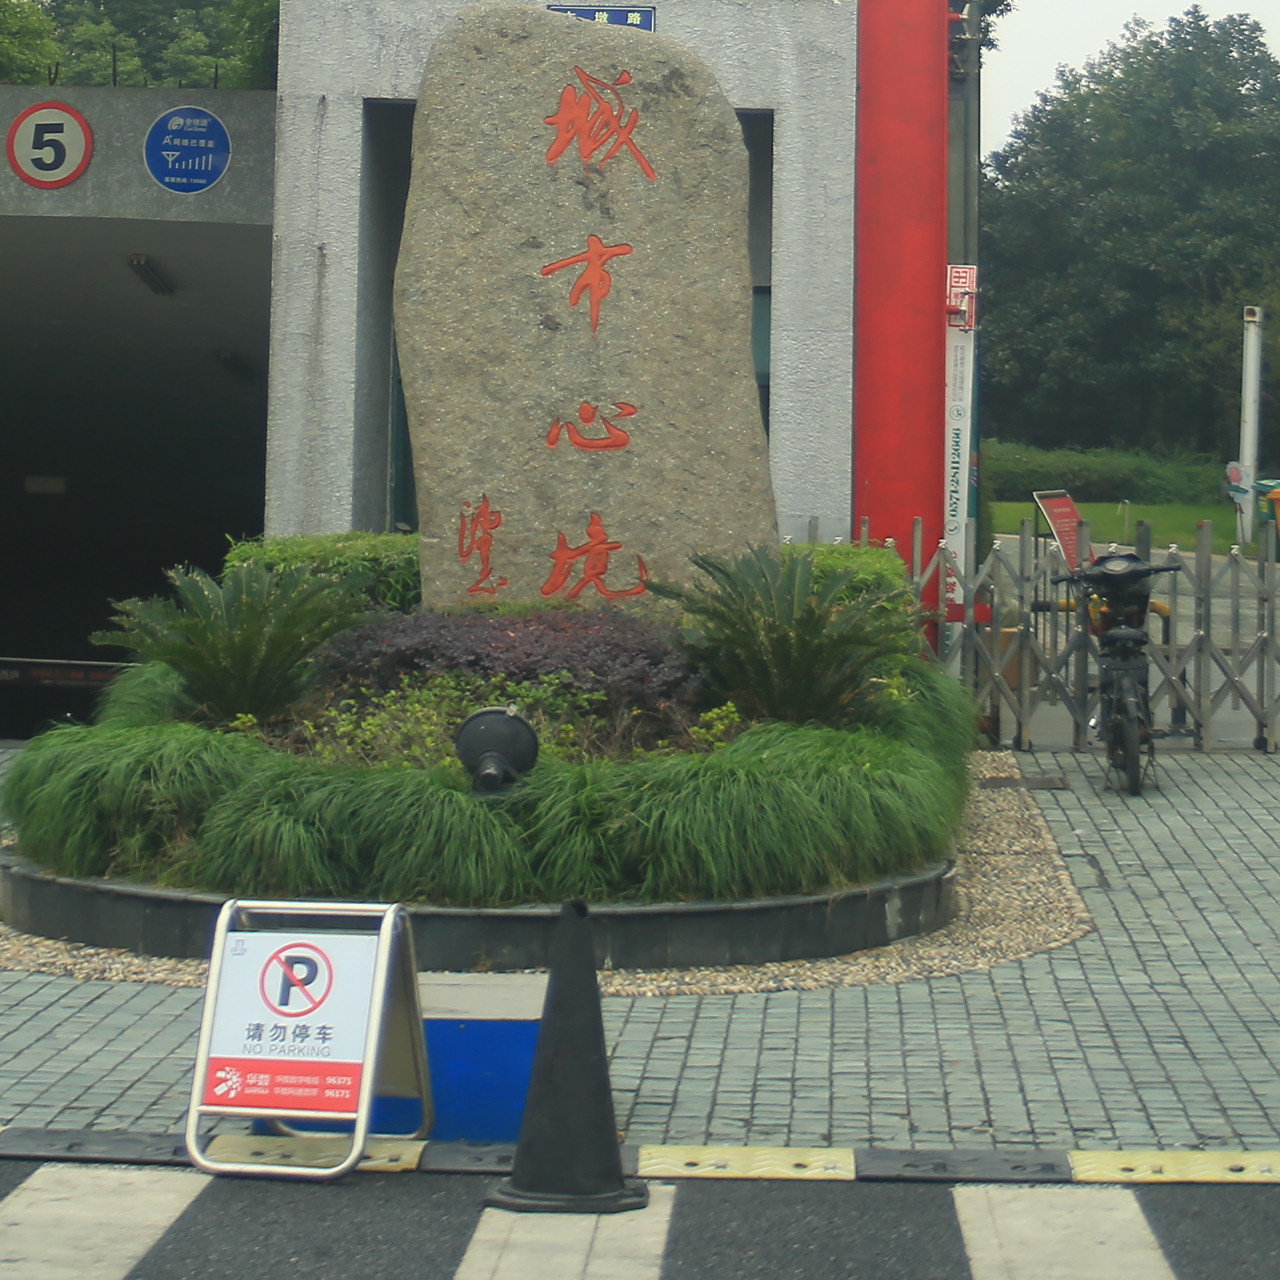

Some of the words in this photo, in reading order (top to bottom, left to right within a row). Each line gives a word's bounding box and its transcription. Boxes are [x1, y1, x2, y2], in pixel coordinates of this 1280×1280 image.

[30, 122, 67, 172] 5
[245, 1022, 335, 1044] 请勿停车
[242, 1043, 263, 1056] NO
[268, 1044, 332, 1058] PARKING
